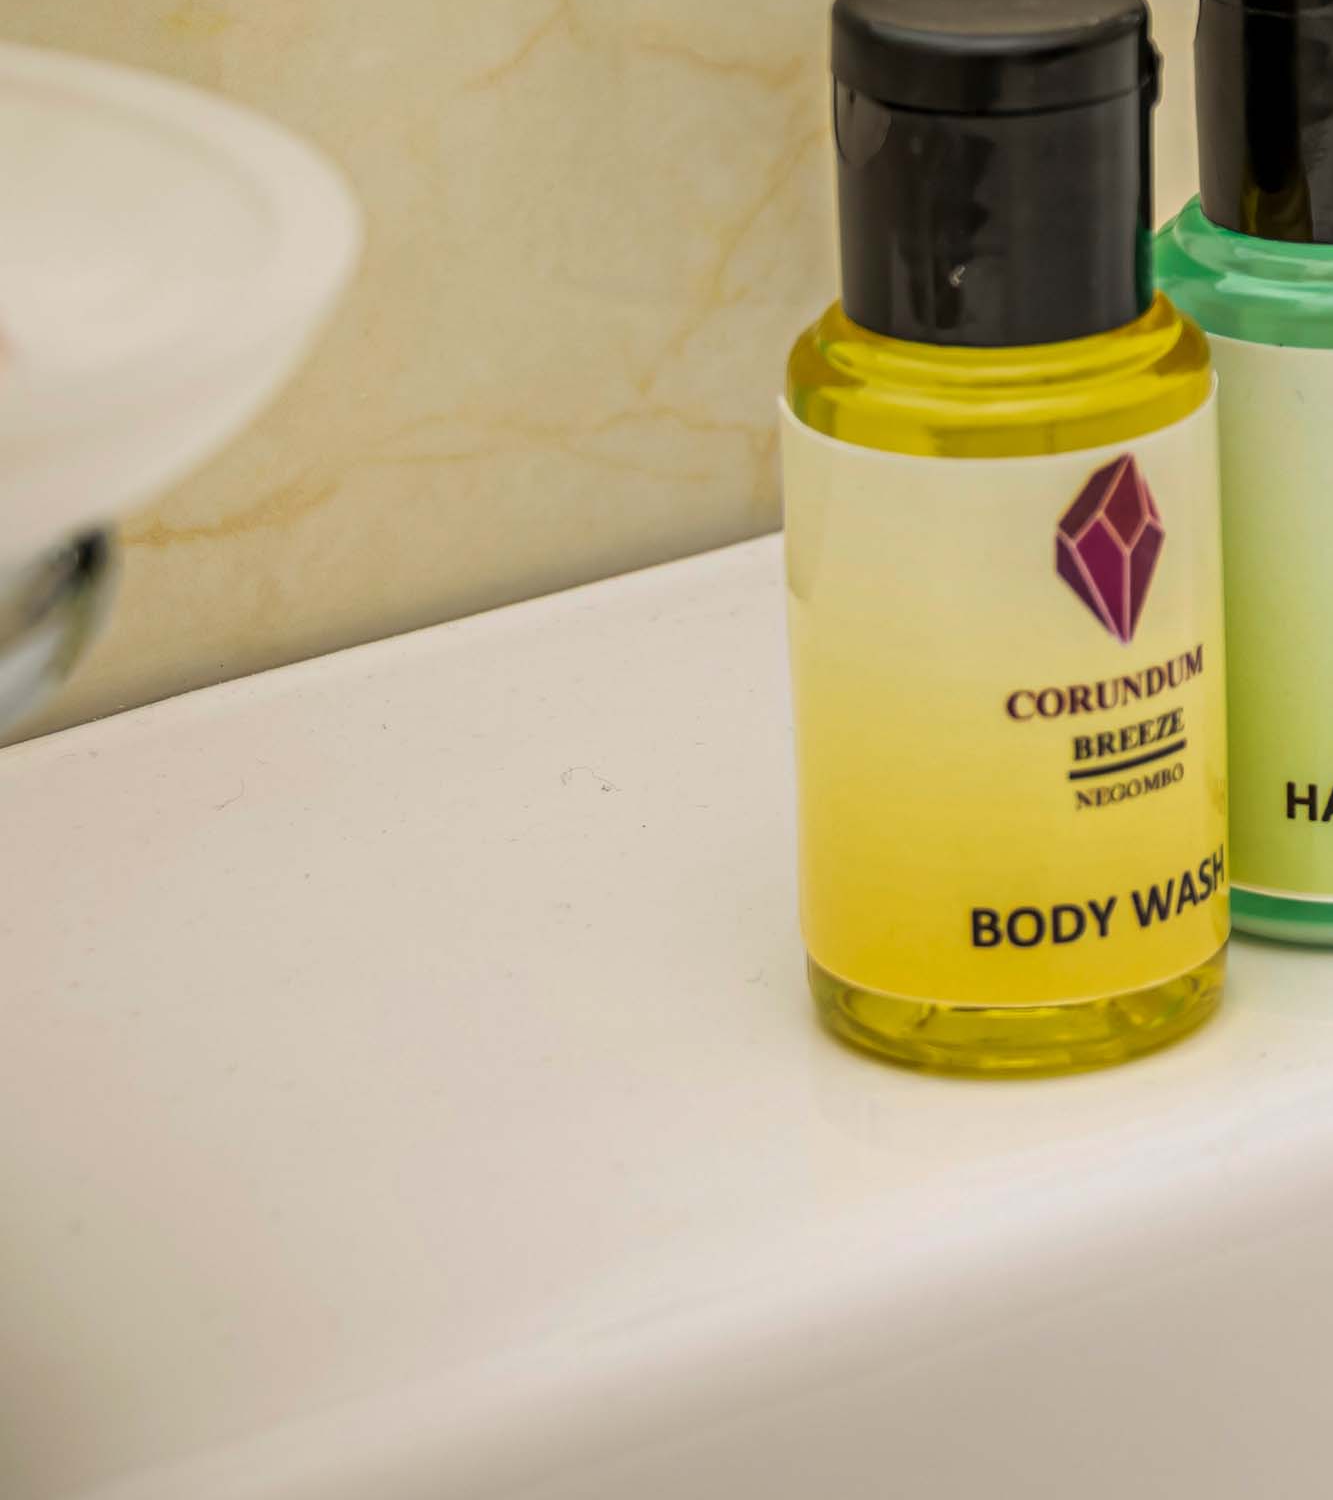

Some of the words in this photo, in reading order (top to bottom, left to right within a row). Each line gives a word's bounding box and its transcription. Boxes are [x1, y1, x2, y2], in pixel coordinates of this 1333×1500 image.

[1005, 643, 1205, 722] CORUNDUM
[1073, 707, 1186, 762] BREEZE
[1075, 762, 1185, 811] NEGOMBO
[971, 896, 1118, 948] BODY
[1131, 844, 1226, 928] WASH
